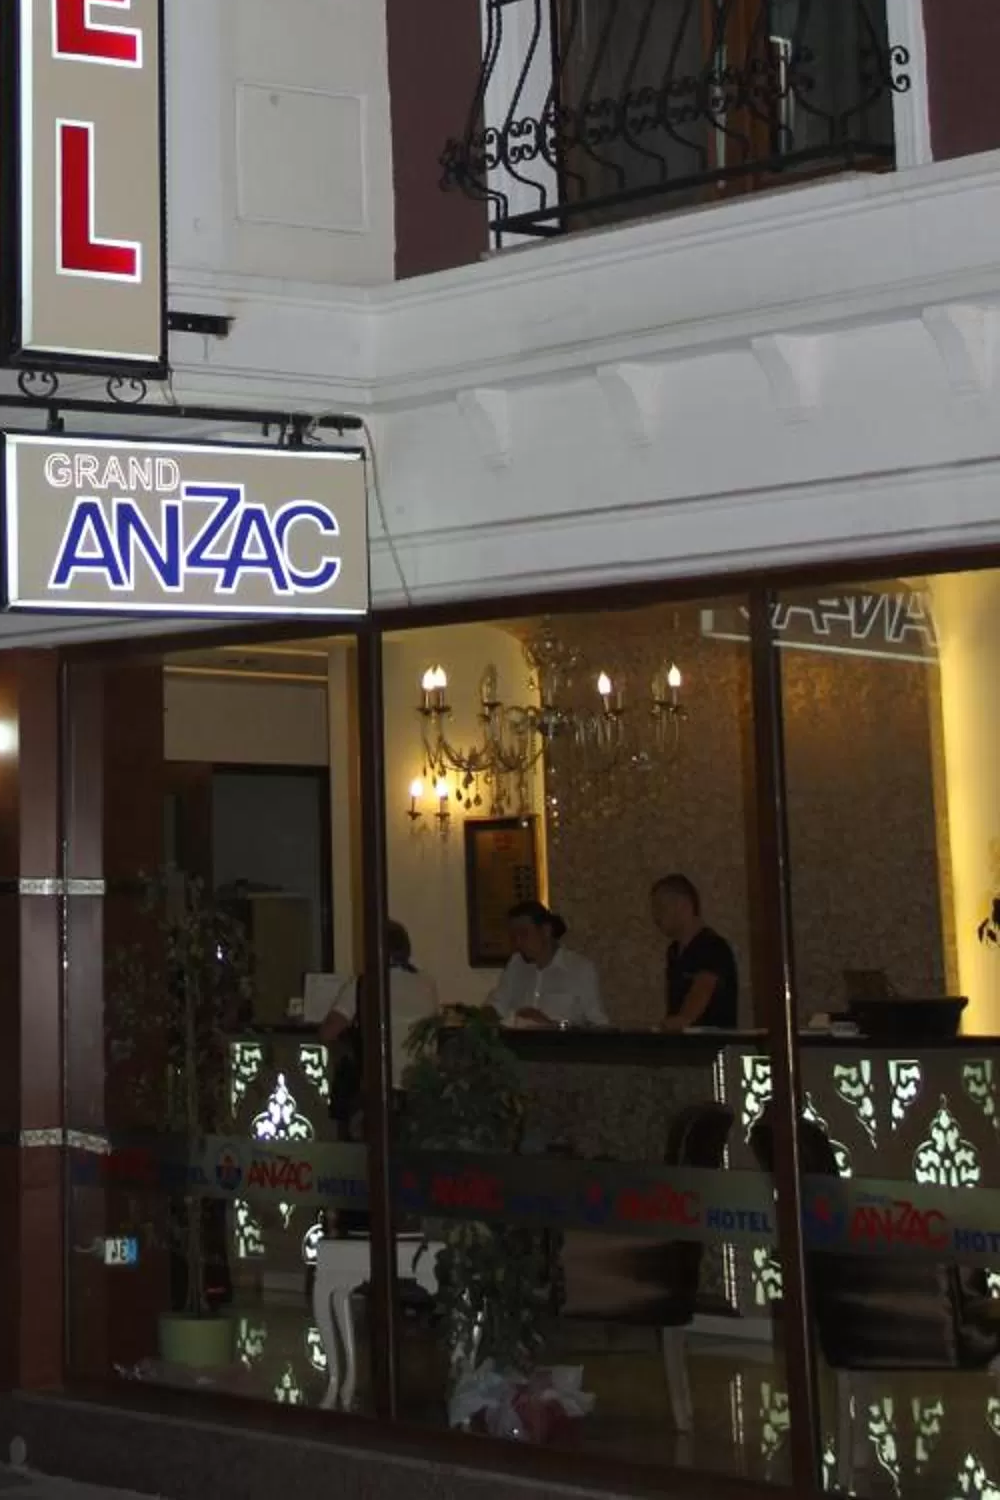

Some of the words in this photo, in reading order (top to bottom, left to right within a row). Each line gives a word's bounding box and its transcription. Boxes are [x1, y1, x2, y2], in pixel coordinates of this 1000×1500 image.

[44, 452, 180, 493] GRAND
[47, 480, 341, 596] ANZAC
[707, 1208, 773, 1232] HOTEL
[849, 1200, 949, 1253] ANZAC
